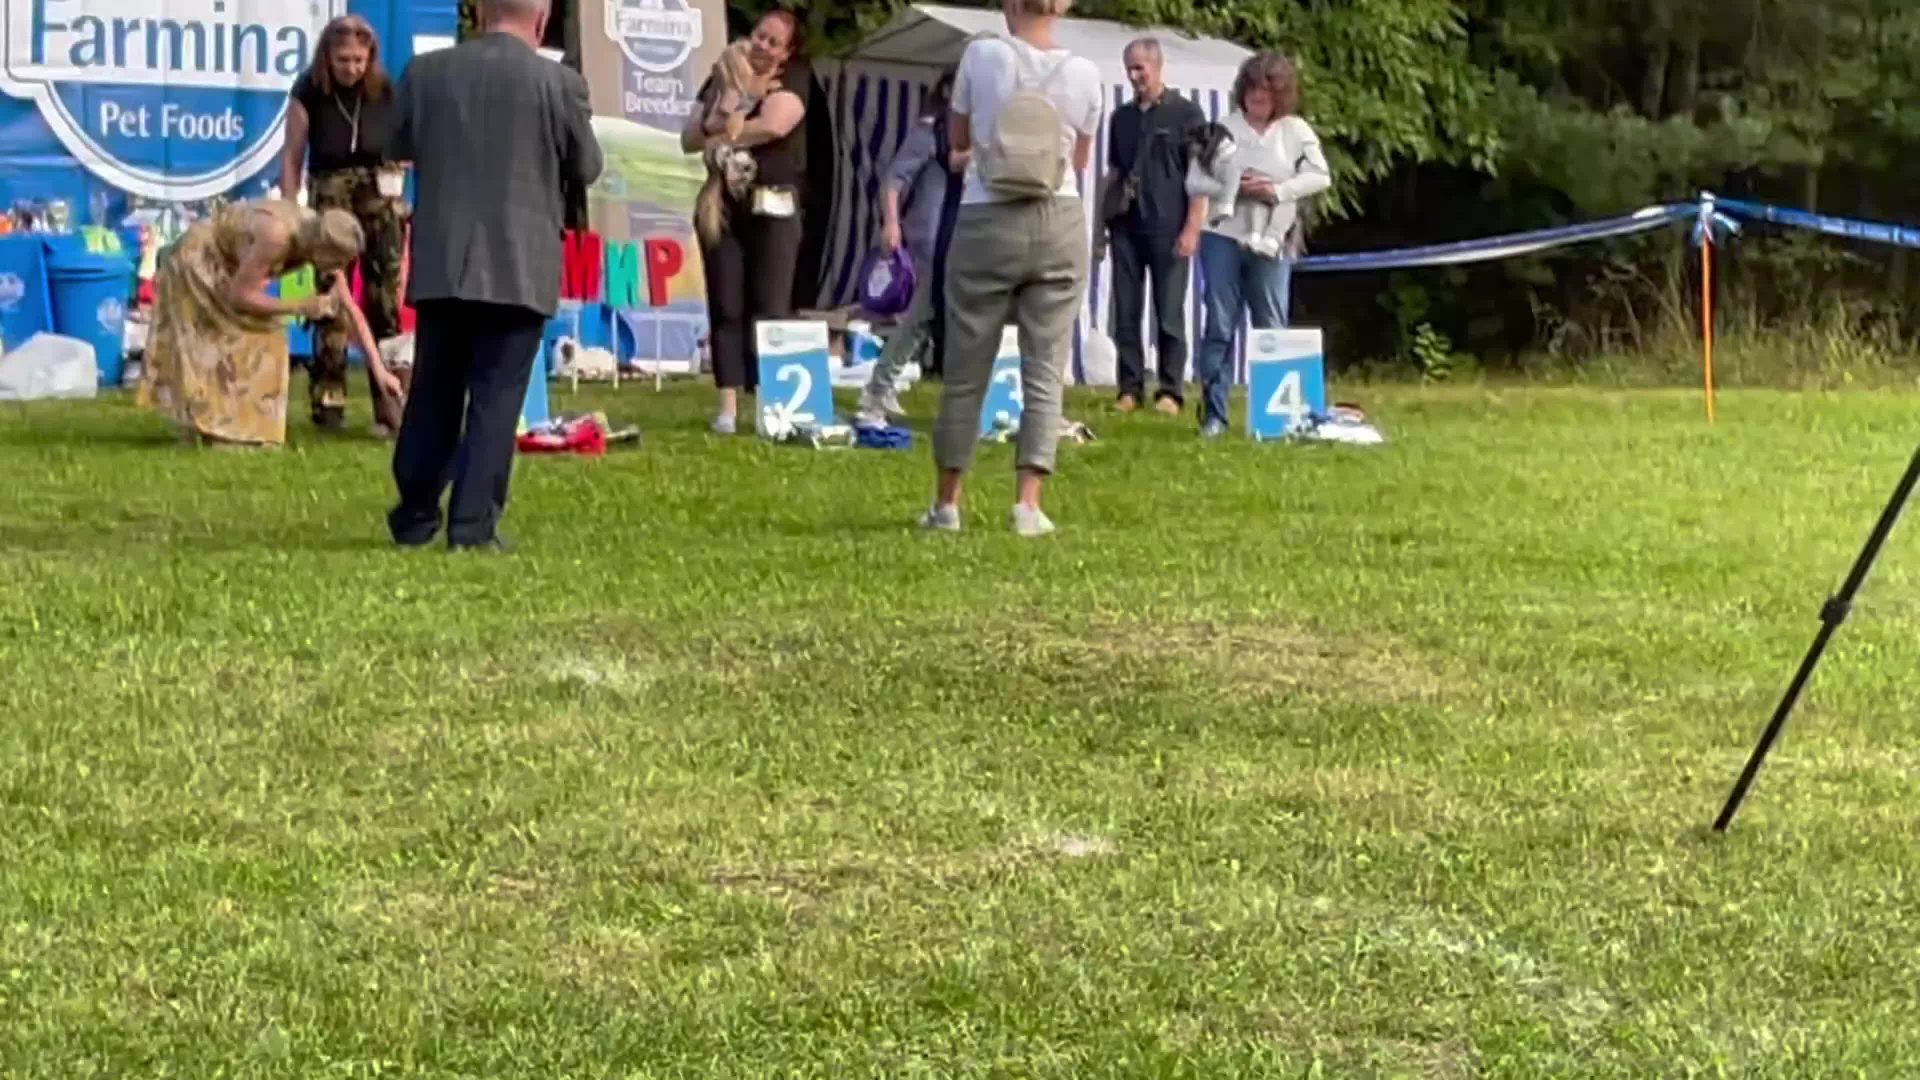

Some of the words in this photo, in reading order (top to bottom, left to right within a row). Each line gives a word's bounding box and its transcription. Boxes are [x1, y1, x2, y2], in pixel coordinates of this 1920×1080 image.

[30, 0, 309, 75] Farmina
[632, 70, 684, 95] Team
[100, 101, 151, 138] Pet
[161, 104, 244, 141] Foods
[775, 363, 815, 423] 2
[1265, 370, 1311, 426] 4
